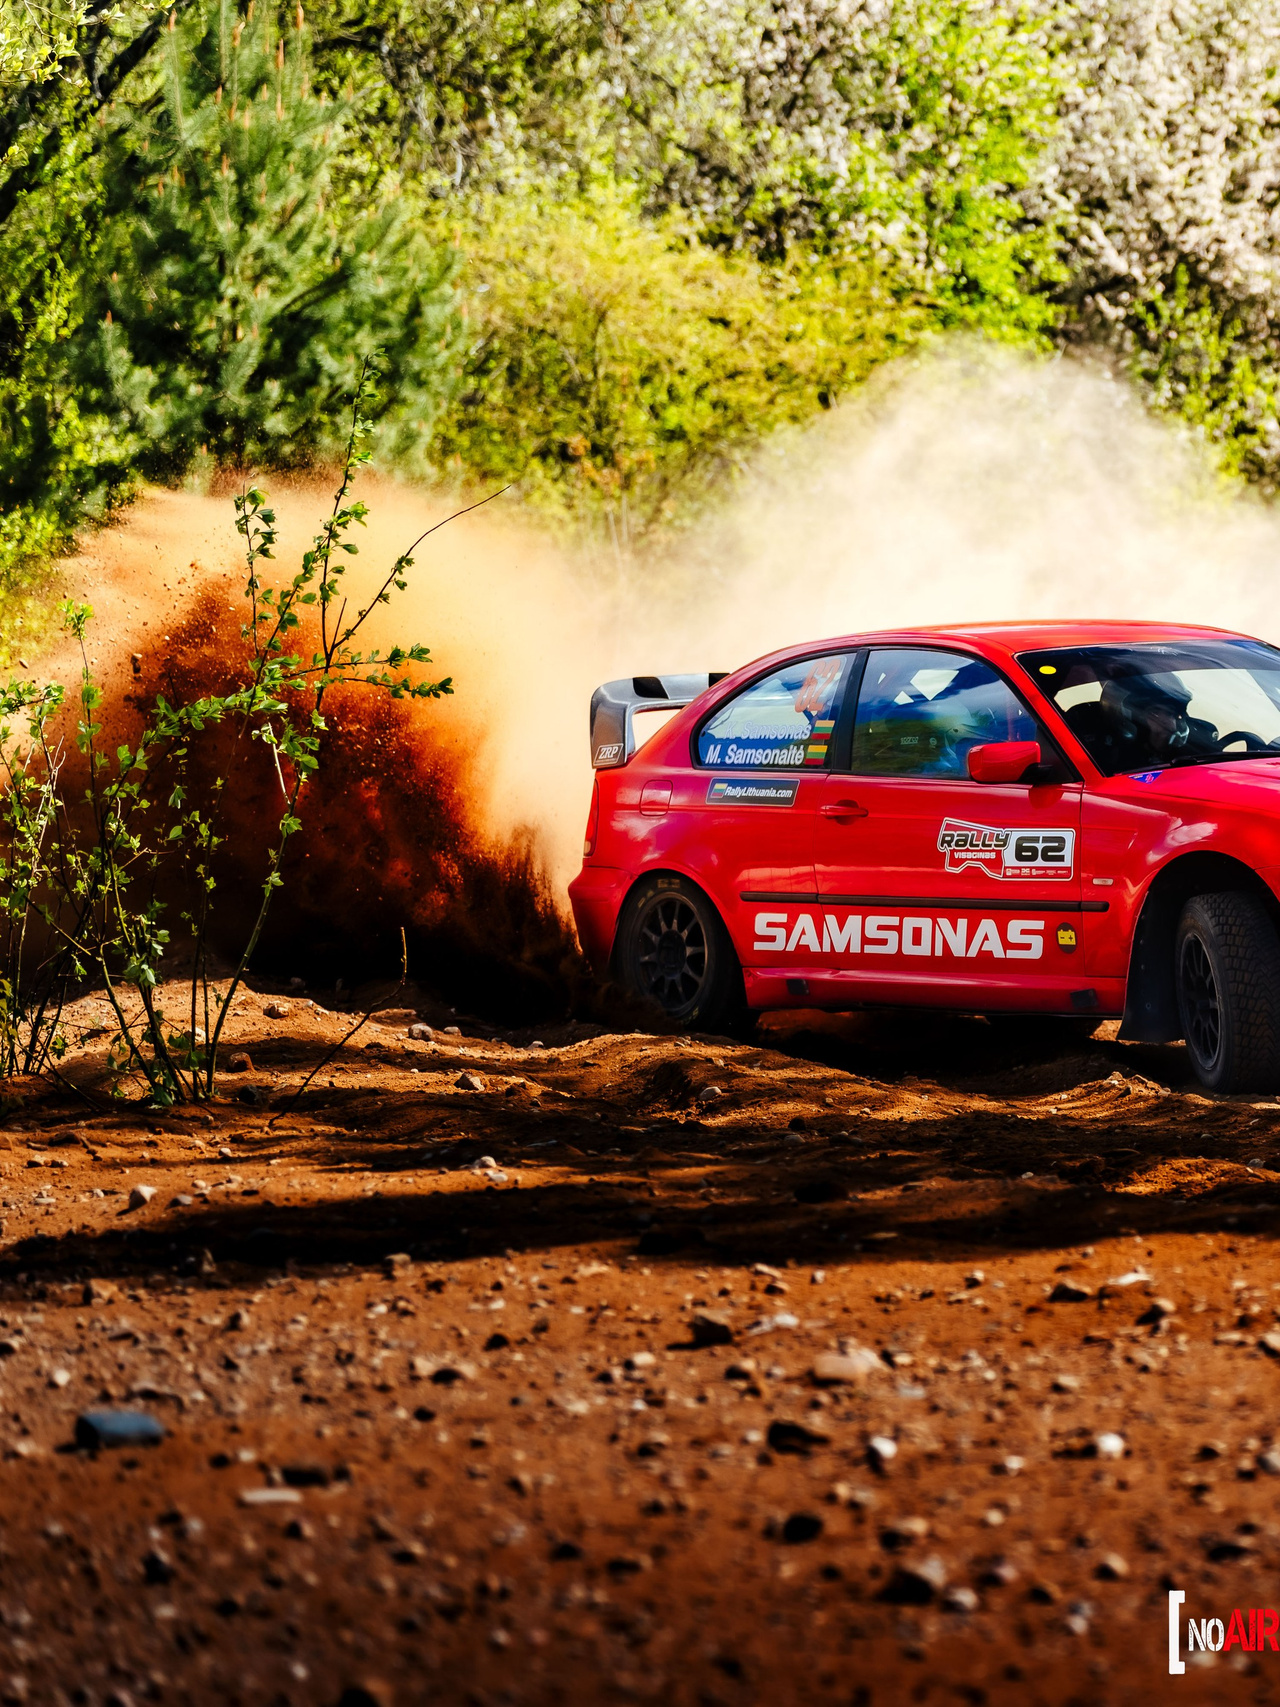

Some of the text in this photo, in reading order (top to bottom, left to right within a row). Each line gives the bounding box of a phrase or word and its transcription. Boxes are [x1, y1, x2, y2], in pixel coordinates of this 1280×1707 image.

[795, 659, 841, 713] 62
[599, 746, 619, 759] ZRP
[705, 743, 804, 765] M. Samsonaitė
[724, 783, 793, 800] RallyLithuania.com
[1014, 835, 1066, 863] 62
[753, 912, 1046, 960] SAMSONAS
